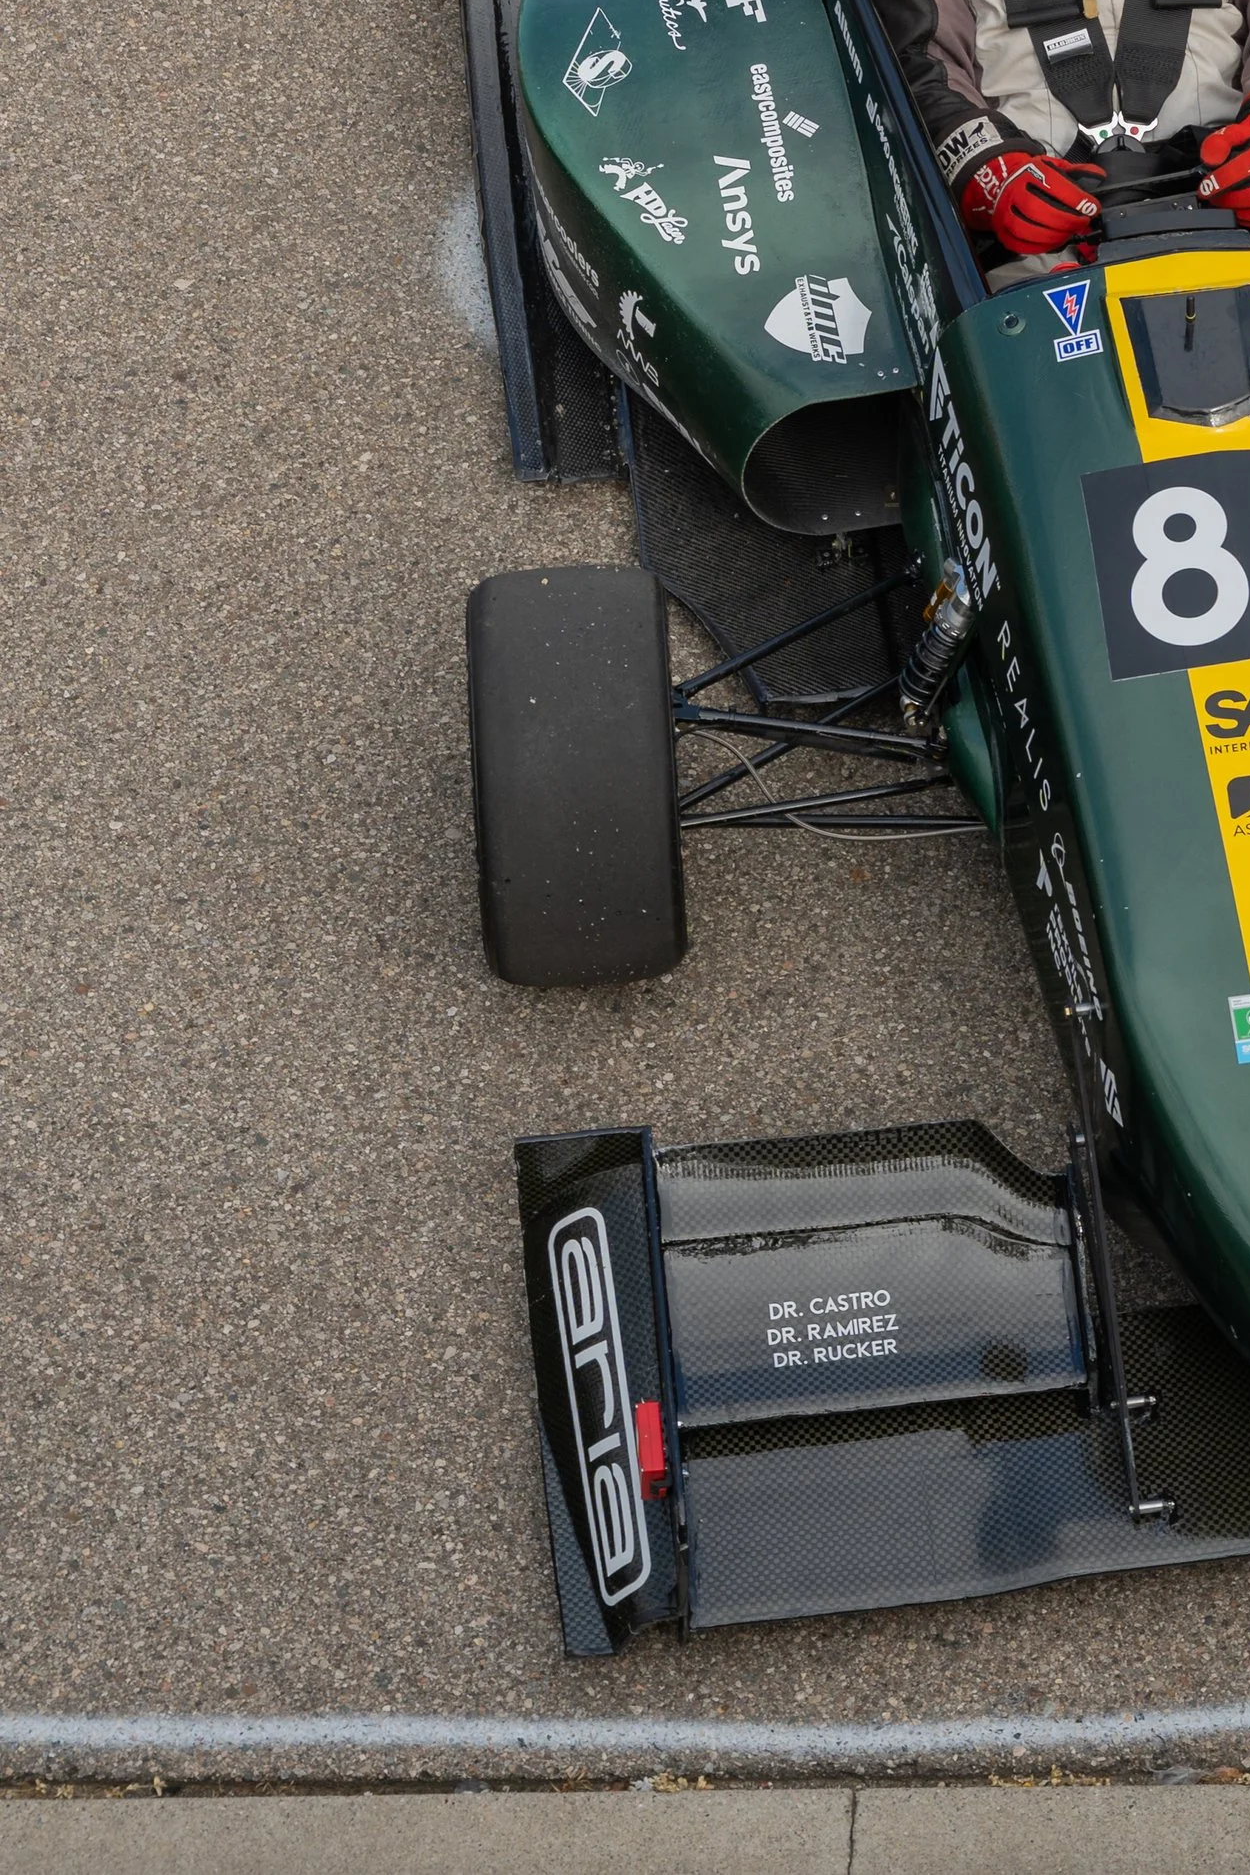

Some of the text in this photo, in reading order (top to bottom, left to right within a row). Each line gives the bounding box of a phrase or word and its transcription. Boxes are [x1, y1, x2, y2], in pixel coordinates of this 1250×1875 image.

[750, 63, 795, 203] easycomposites
[937, 130, 970, 171] OW
[947, 137, 989, 177] PRIZES
[713, 155, 762, 275] Ansys
[796, 278, 810, 312] EXHAUST
[897, 241, 931, 355] Calspan
[805, 317, 815, 332] FAB
[806, 274, 846, 362] dmc
[809, 332, 821, 360] WERKS
[1061, 336, 1095, 356] OFF
[938, 443, 984, 613] TITANIUM INNOVATION
[1065, 881, 1104, 1021] BOEING
[1050, 909, 1092, 1058] PRODUTS
[768, 1289, 891, 1320] DR. CASTRO
[766, 1313, 899, 1345] DR. RAMIREZ
[773, 1338, 898, 1368] DR. RUCKER
